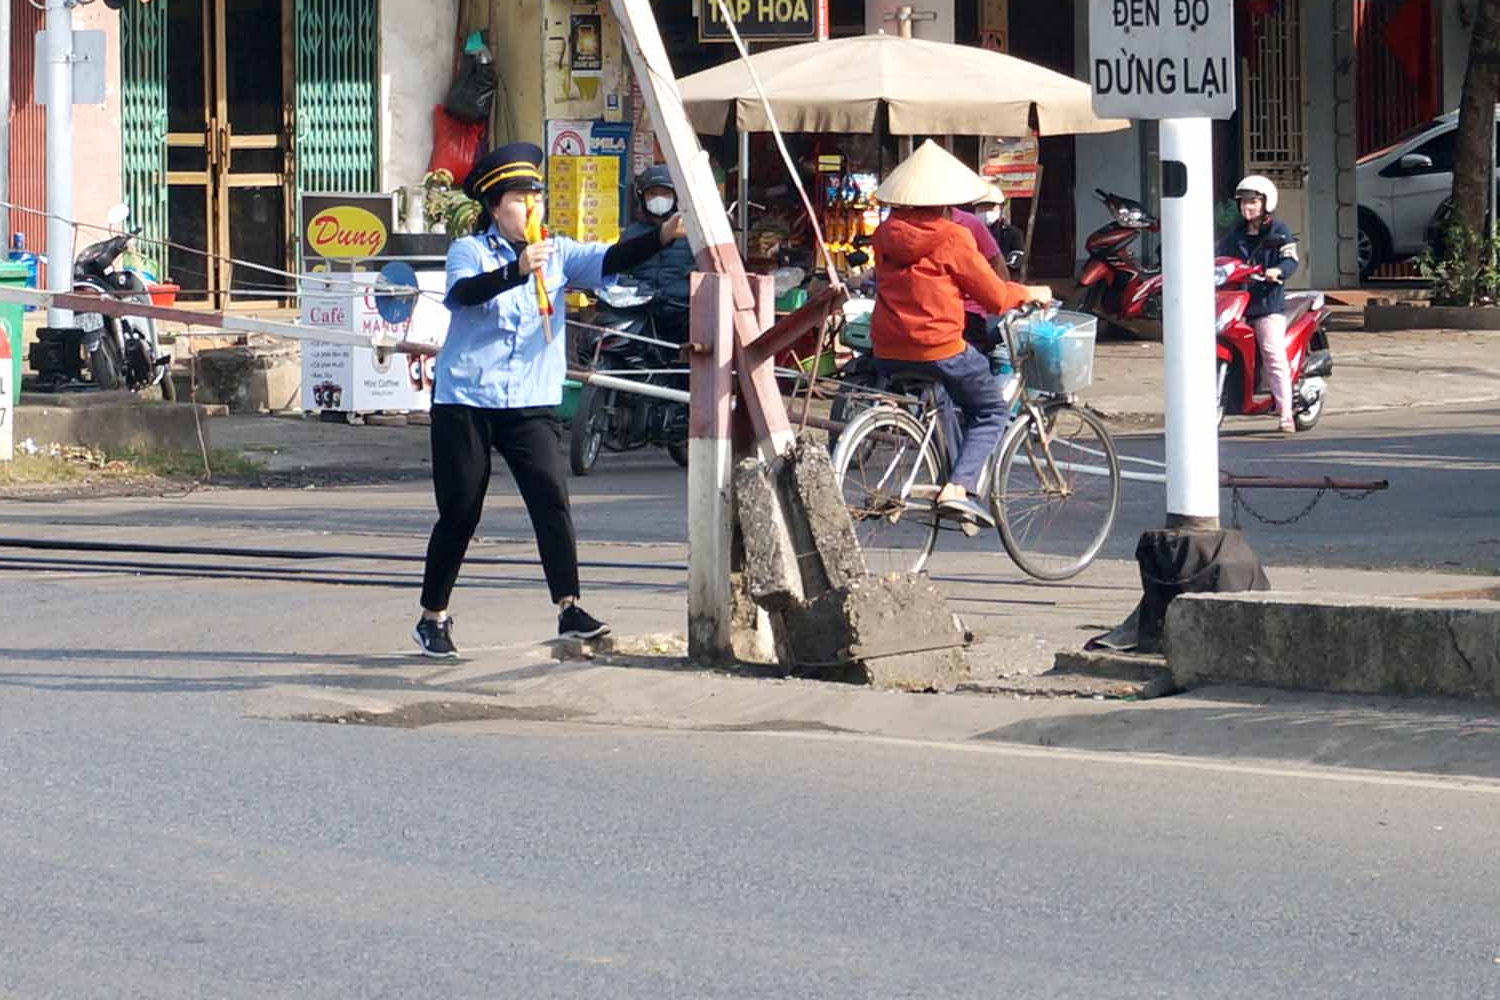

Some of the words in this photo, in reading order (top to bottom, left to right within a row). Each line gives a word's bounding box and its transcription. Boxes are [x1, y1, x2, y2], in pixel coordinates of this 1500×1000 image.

[1095, 48, 1176, 95] DỪNG
[1184, 57, 1227, 98] LẠI
[315, 215, 381, 256] Dung
[310, 307, 345, 323] Café
